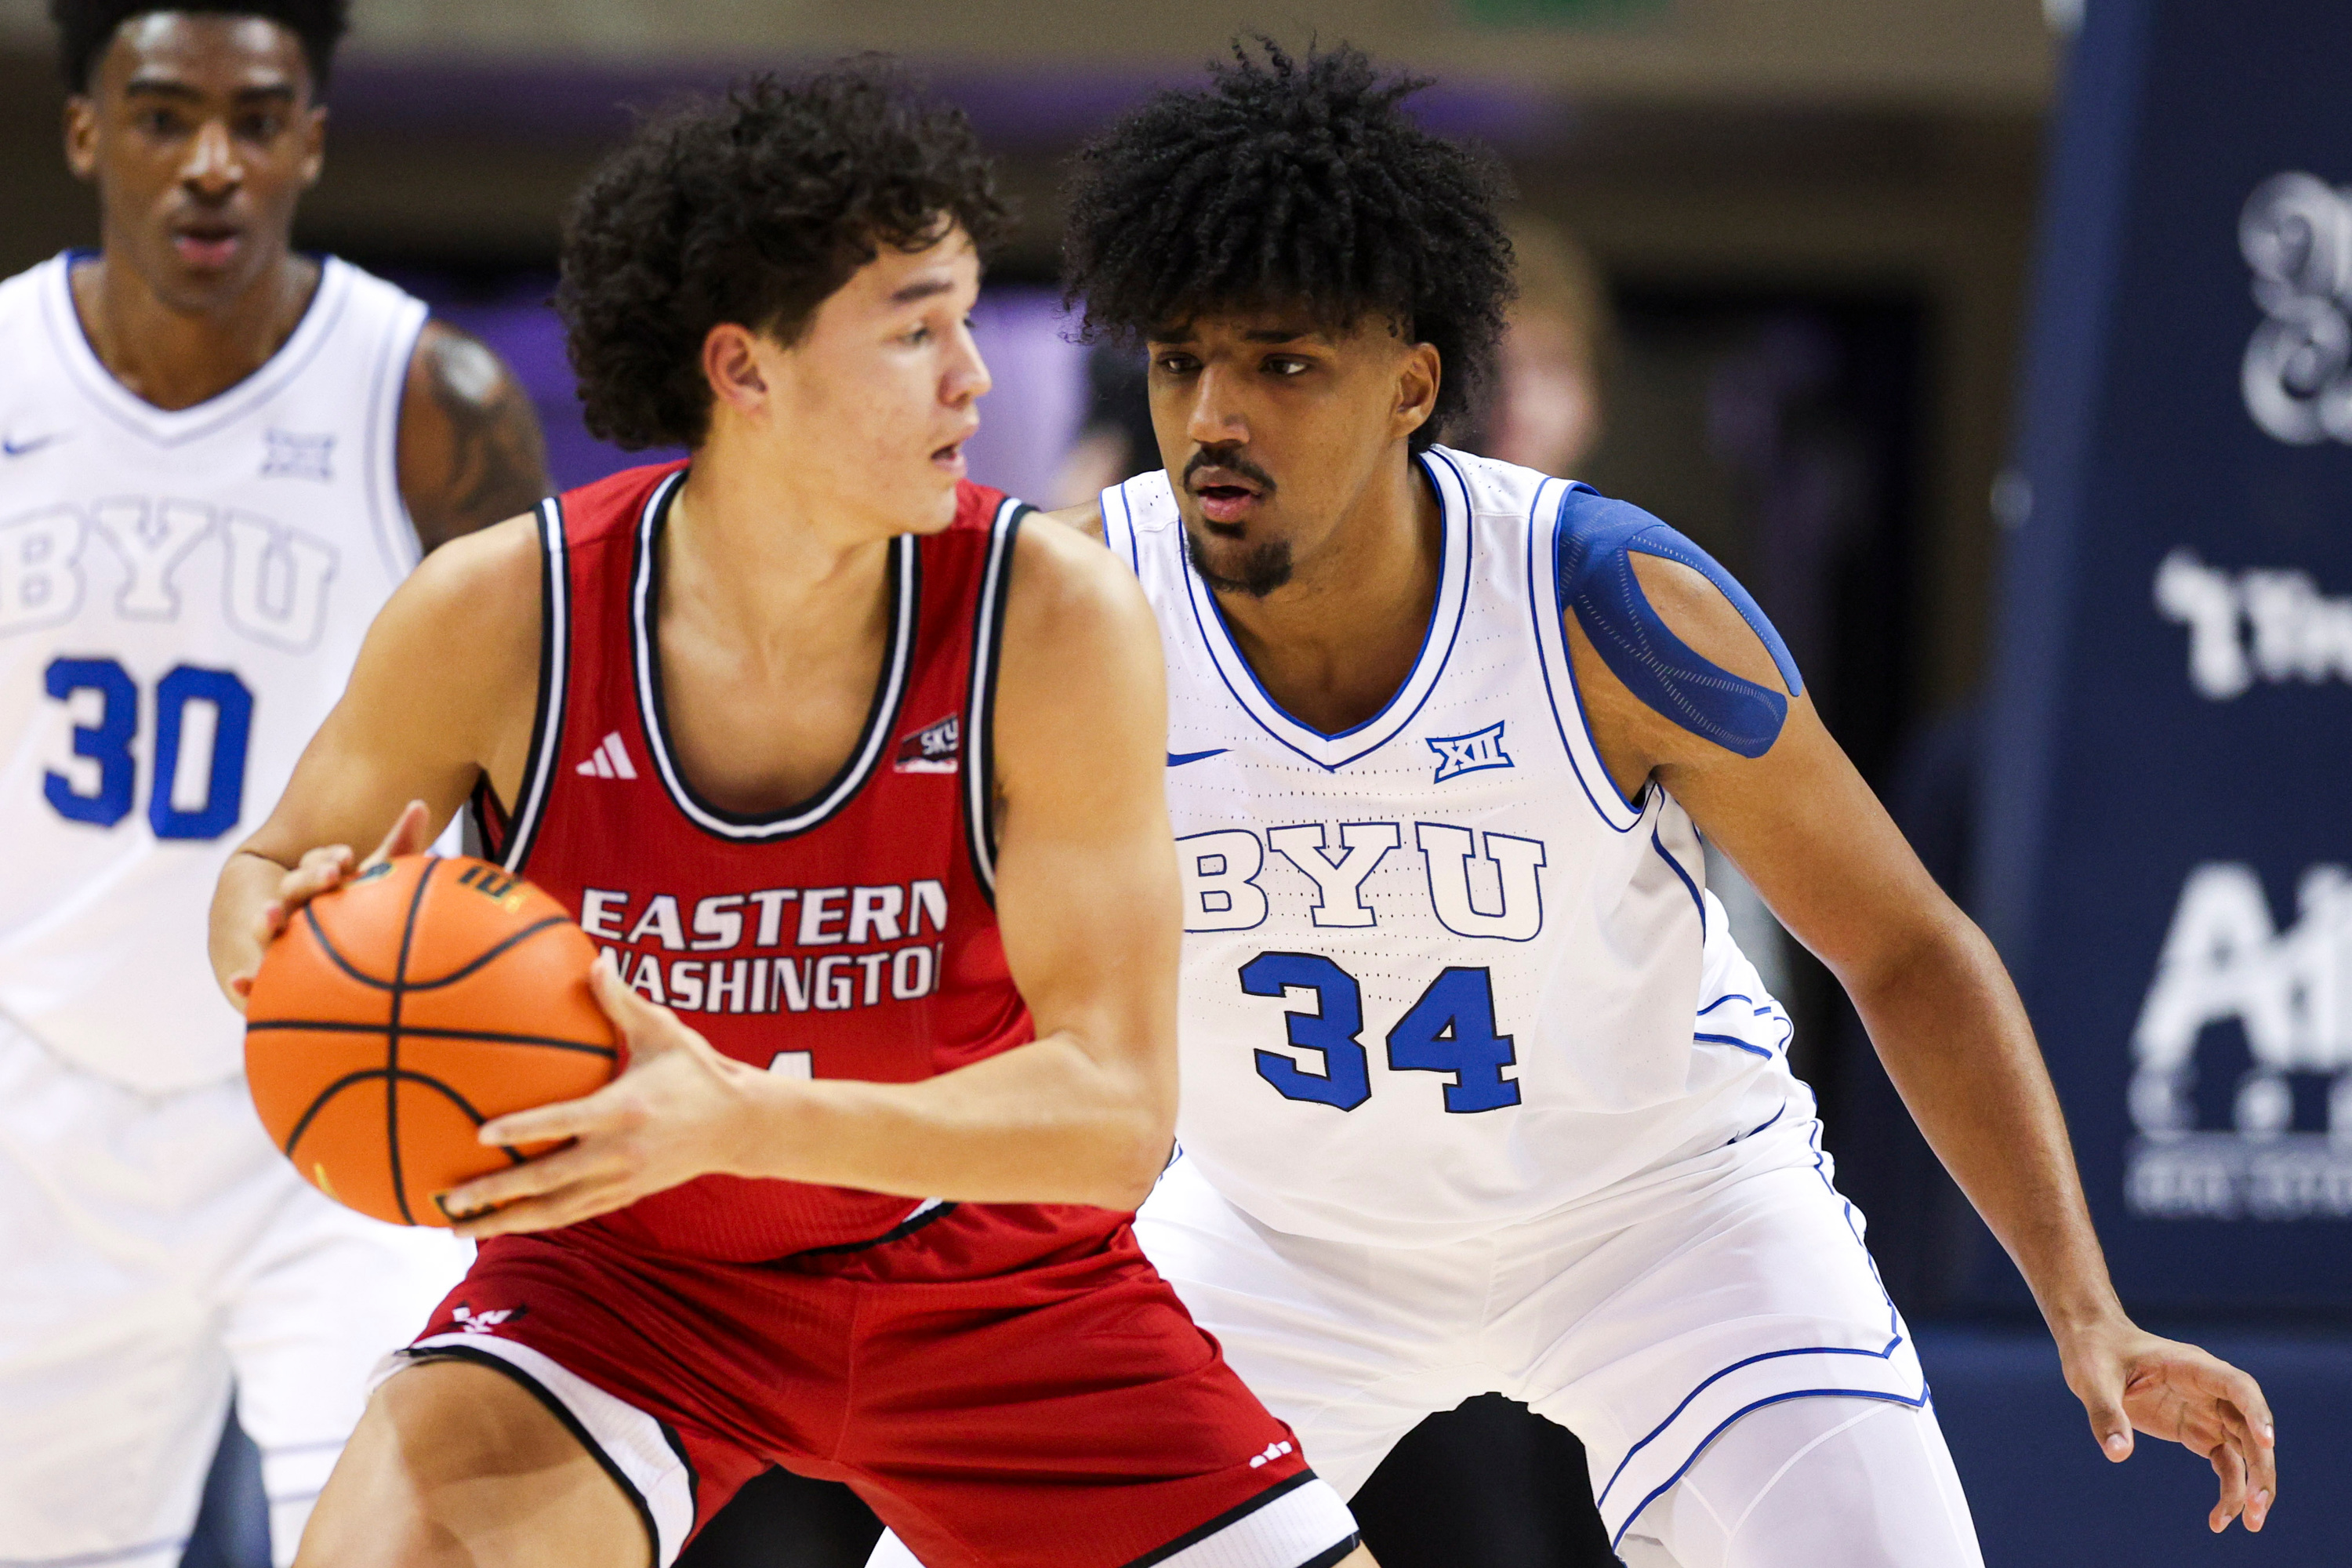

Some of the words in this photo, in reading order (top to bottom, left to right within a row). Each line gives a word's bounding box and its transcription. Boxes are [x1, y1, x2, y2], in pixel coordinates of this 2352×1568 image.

[0, 495, 340, 657] BYU
[44, 655, 254, 840] 30
[920, 717, 959, 755] SKY
[581, 879, 948, 951] EASTERN
[1174, 822, 1547, 942] BYU
[1238, 951, 1522, 1113] 34
